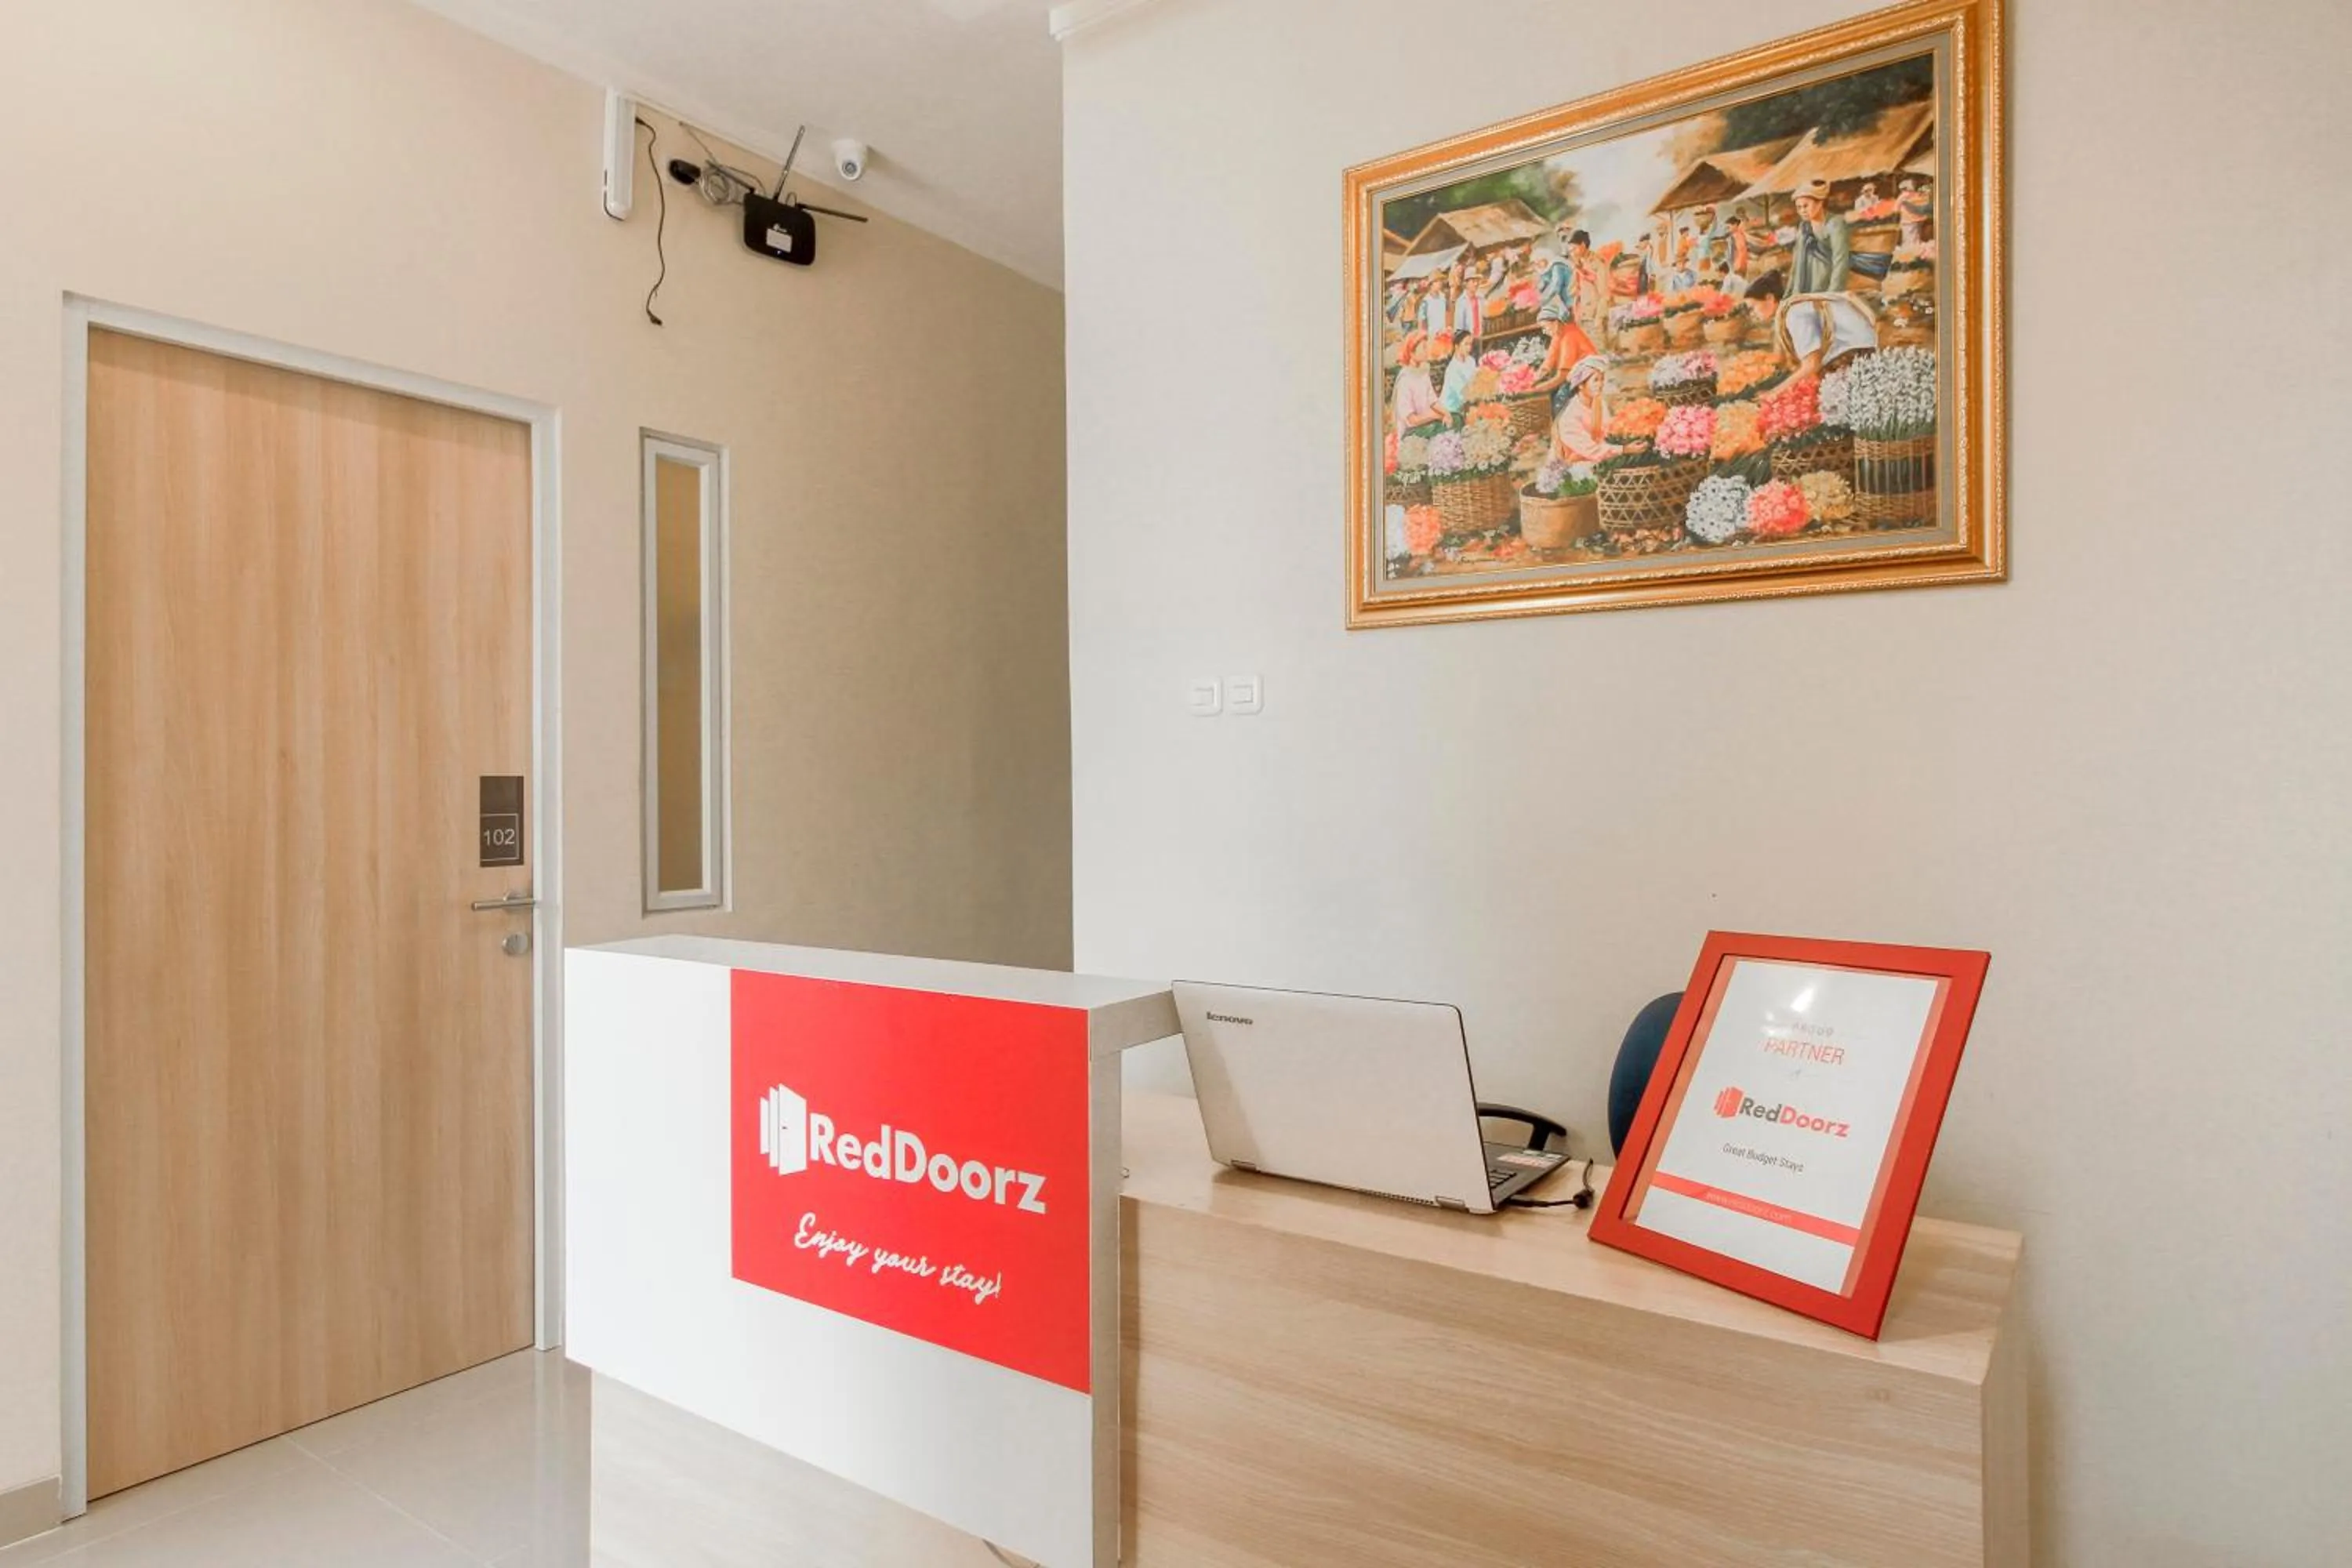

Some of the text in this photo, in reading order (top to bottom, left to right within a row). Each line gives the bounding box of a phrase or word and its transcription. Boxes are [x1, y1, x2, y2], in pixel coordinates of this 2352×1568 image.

[483, 828, 515, 845] 102
[1206, 1011, 1254, 1025] lenovo
[1763, 1038, 1846, 1065] PARTNER
[1739, 1097, 1850, 1138] RedDoorz
[809, 1112, 1047, 1214] RedDoorz
[1722, 1142, 1746, 1158] Great
[1747, 1148, 1777, 1166] Budget
[794, 1211, 1003, 1305] Enjoy your stay!
